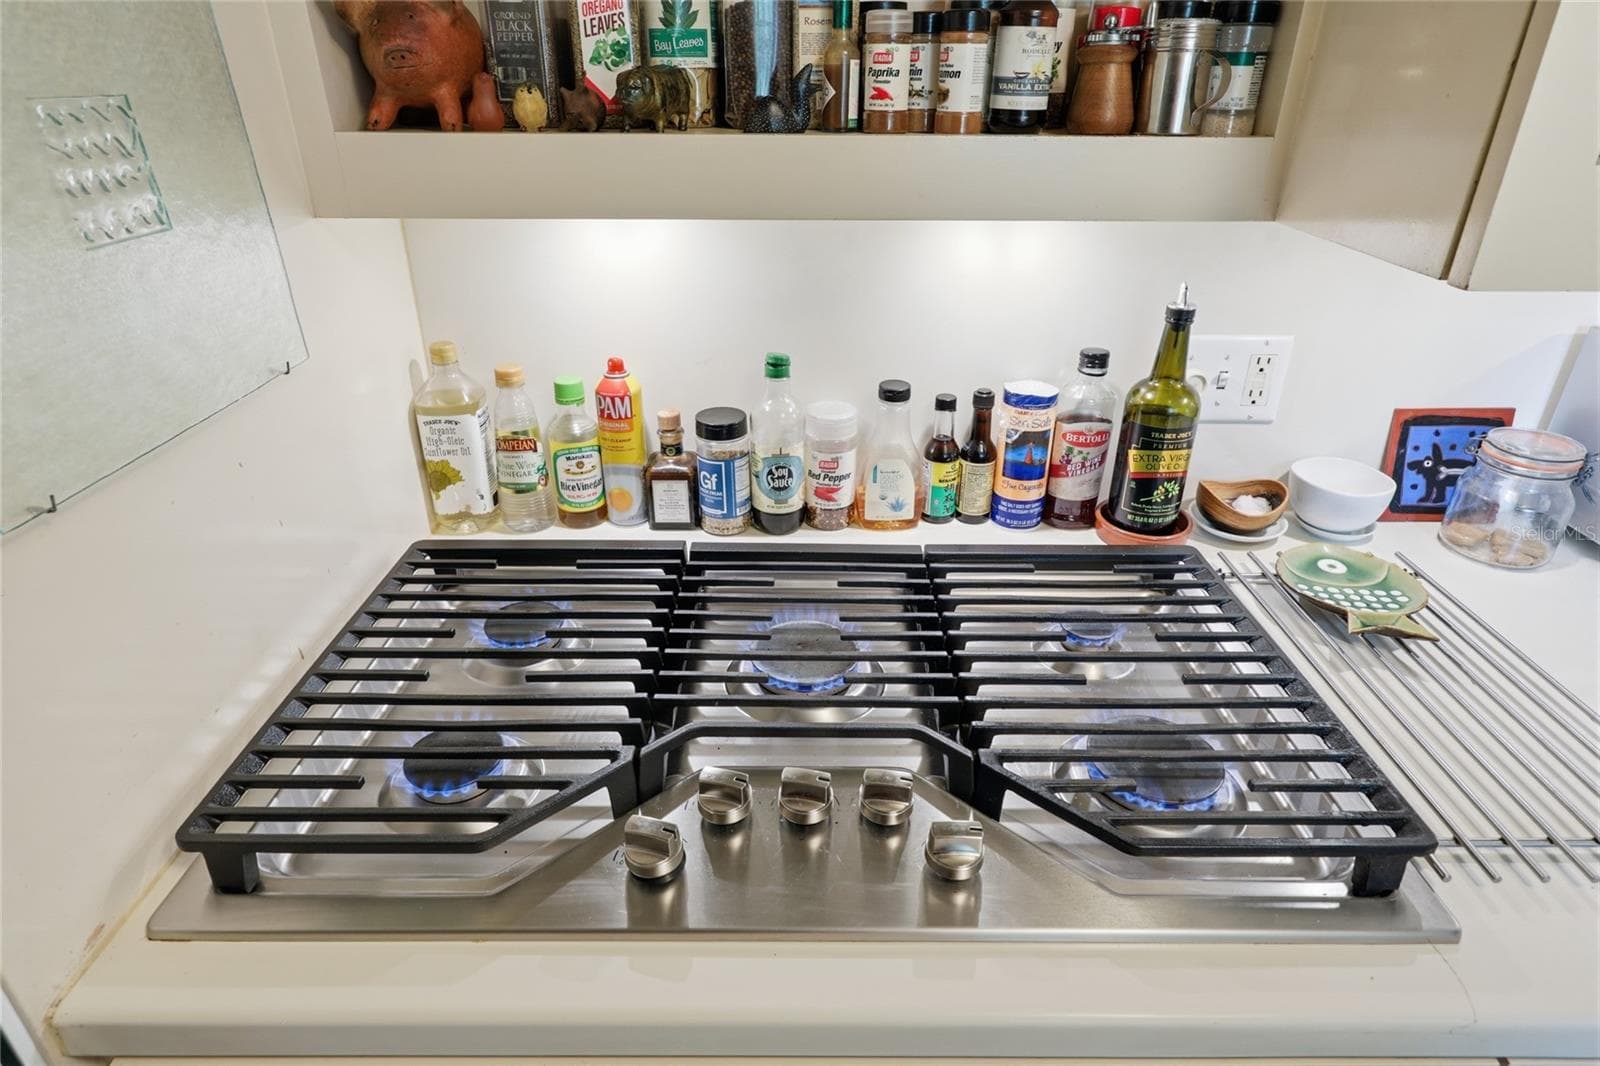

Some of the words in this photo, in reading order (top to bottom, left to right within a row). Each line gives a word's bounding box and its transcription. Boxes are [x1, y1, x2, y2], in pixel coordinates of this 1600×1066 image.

[582, 0, 624, 17] OREGANO
[494, 11, 532, 20] GROUND
[496, 20, 534, 32] BLACK
[583, 11, 625, 38] LEAVES
[497, 31, 535, 42] PEPPER
[654, 39, 672, 54] Bay
[672, 36, 704, 50] Leaves
[867, 67, 900, 78] Paprika
[597, 396, 632, 419] PAM
[429, 427, 456, 438] Organic
[1066, 432, 1110, 443] BERTOLLI
[1151, 432, 1176, 440] TRADER
[426, 436, 465, 448] High-Oleic
[425, 447, 461, 457] Sunflower
[462, 446, 472, 456] Oil
[1067, 462, 1082, 471] RED
[1085, 454, 1102, 466] WINE
[1132, 454, 1166, 463] EXTRA
[1169, 453, 1190, 462] VIRG
[772, 466, 789, 479] Soy
[1068, 462, 1100, 477] VINEGAR
[1145, 463, 1172, 471] OLIVE
[700, 471, 718, 490] Gf
[768, 475, 793, 489] Sauce
[808, 469, 821, 480] Red
[823, 472, 851, 484] Pepper
[576, 478, 602, 491] Vinegar
